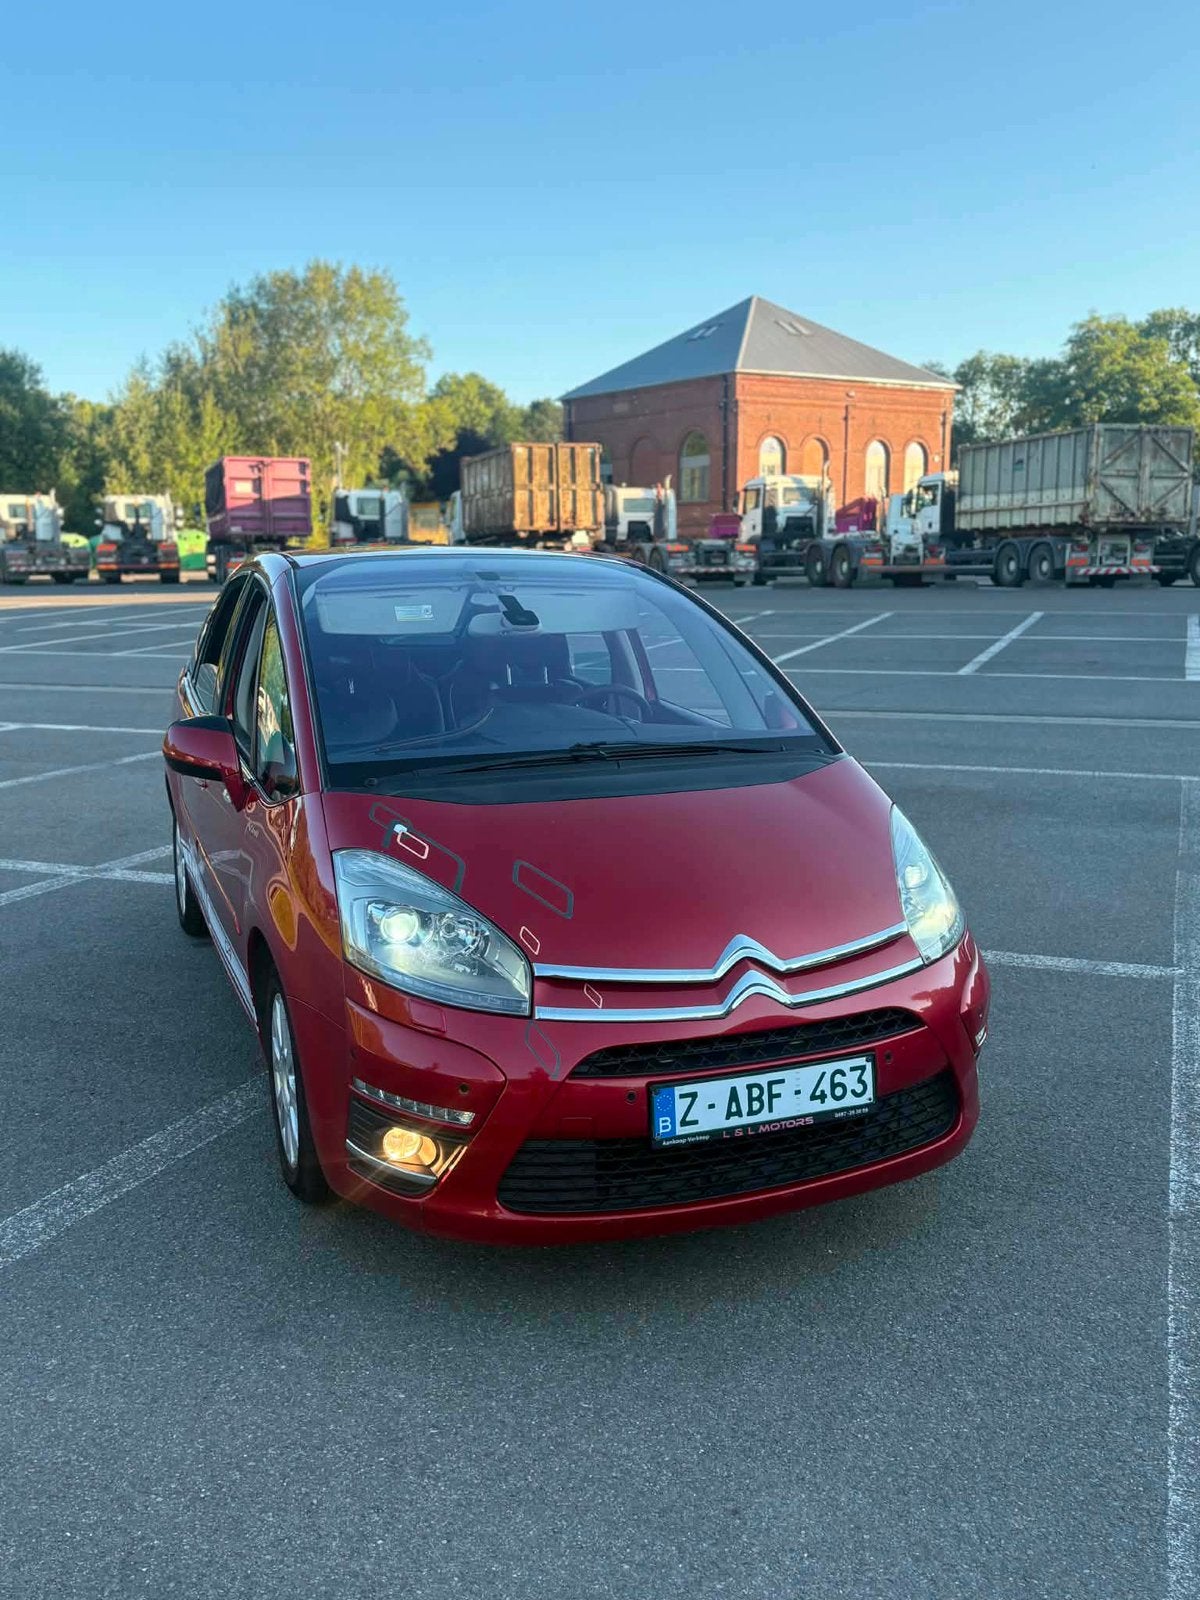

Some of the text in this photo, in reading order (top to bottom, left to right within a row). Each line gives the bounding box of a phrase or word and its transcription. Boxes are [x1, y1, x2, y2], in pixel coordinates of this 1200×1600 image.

[659, 1117, 671, 1132] B
[747, 1127, 756, 1135] L
[758, 1116, 814, 1133] MOTORS
